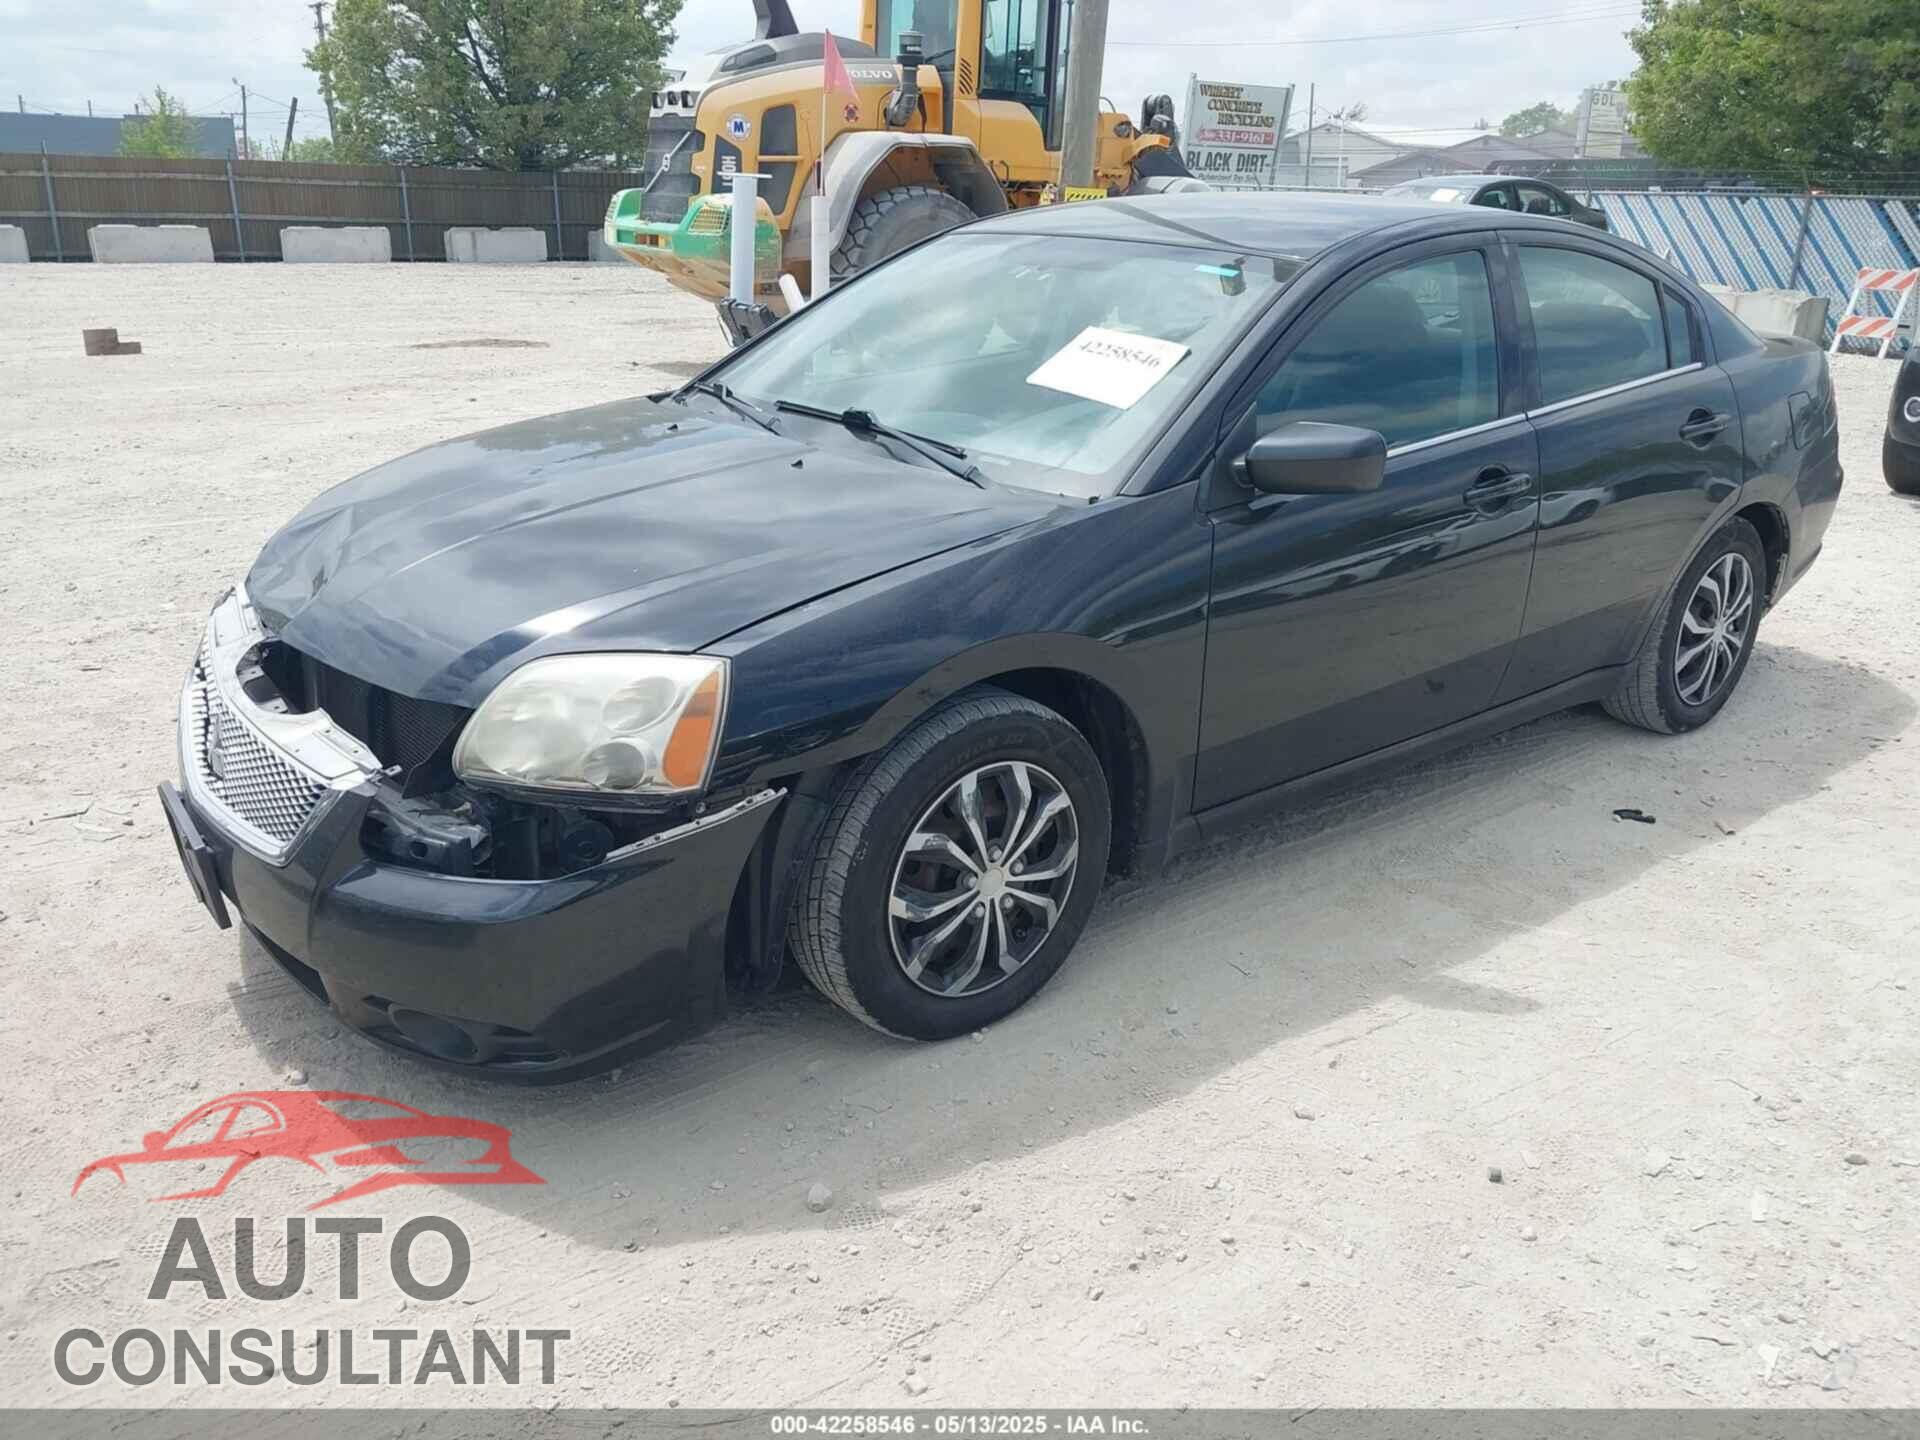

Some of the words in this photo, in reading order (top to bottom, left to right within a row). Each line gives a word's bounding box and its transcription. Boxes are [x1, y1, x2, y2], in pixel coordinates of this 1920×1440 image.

[843, 69, 893, 79] OLVO
[1208, 98, 1263, 114] CONCRETE
[733, 120, 745, 133] M
[1217, 112, 1275, 128] RECYCLING
[1186, 150, 1233, 172] BLACK
[1080, 341, 1160, 368] 42258546
